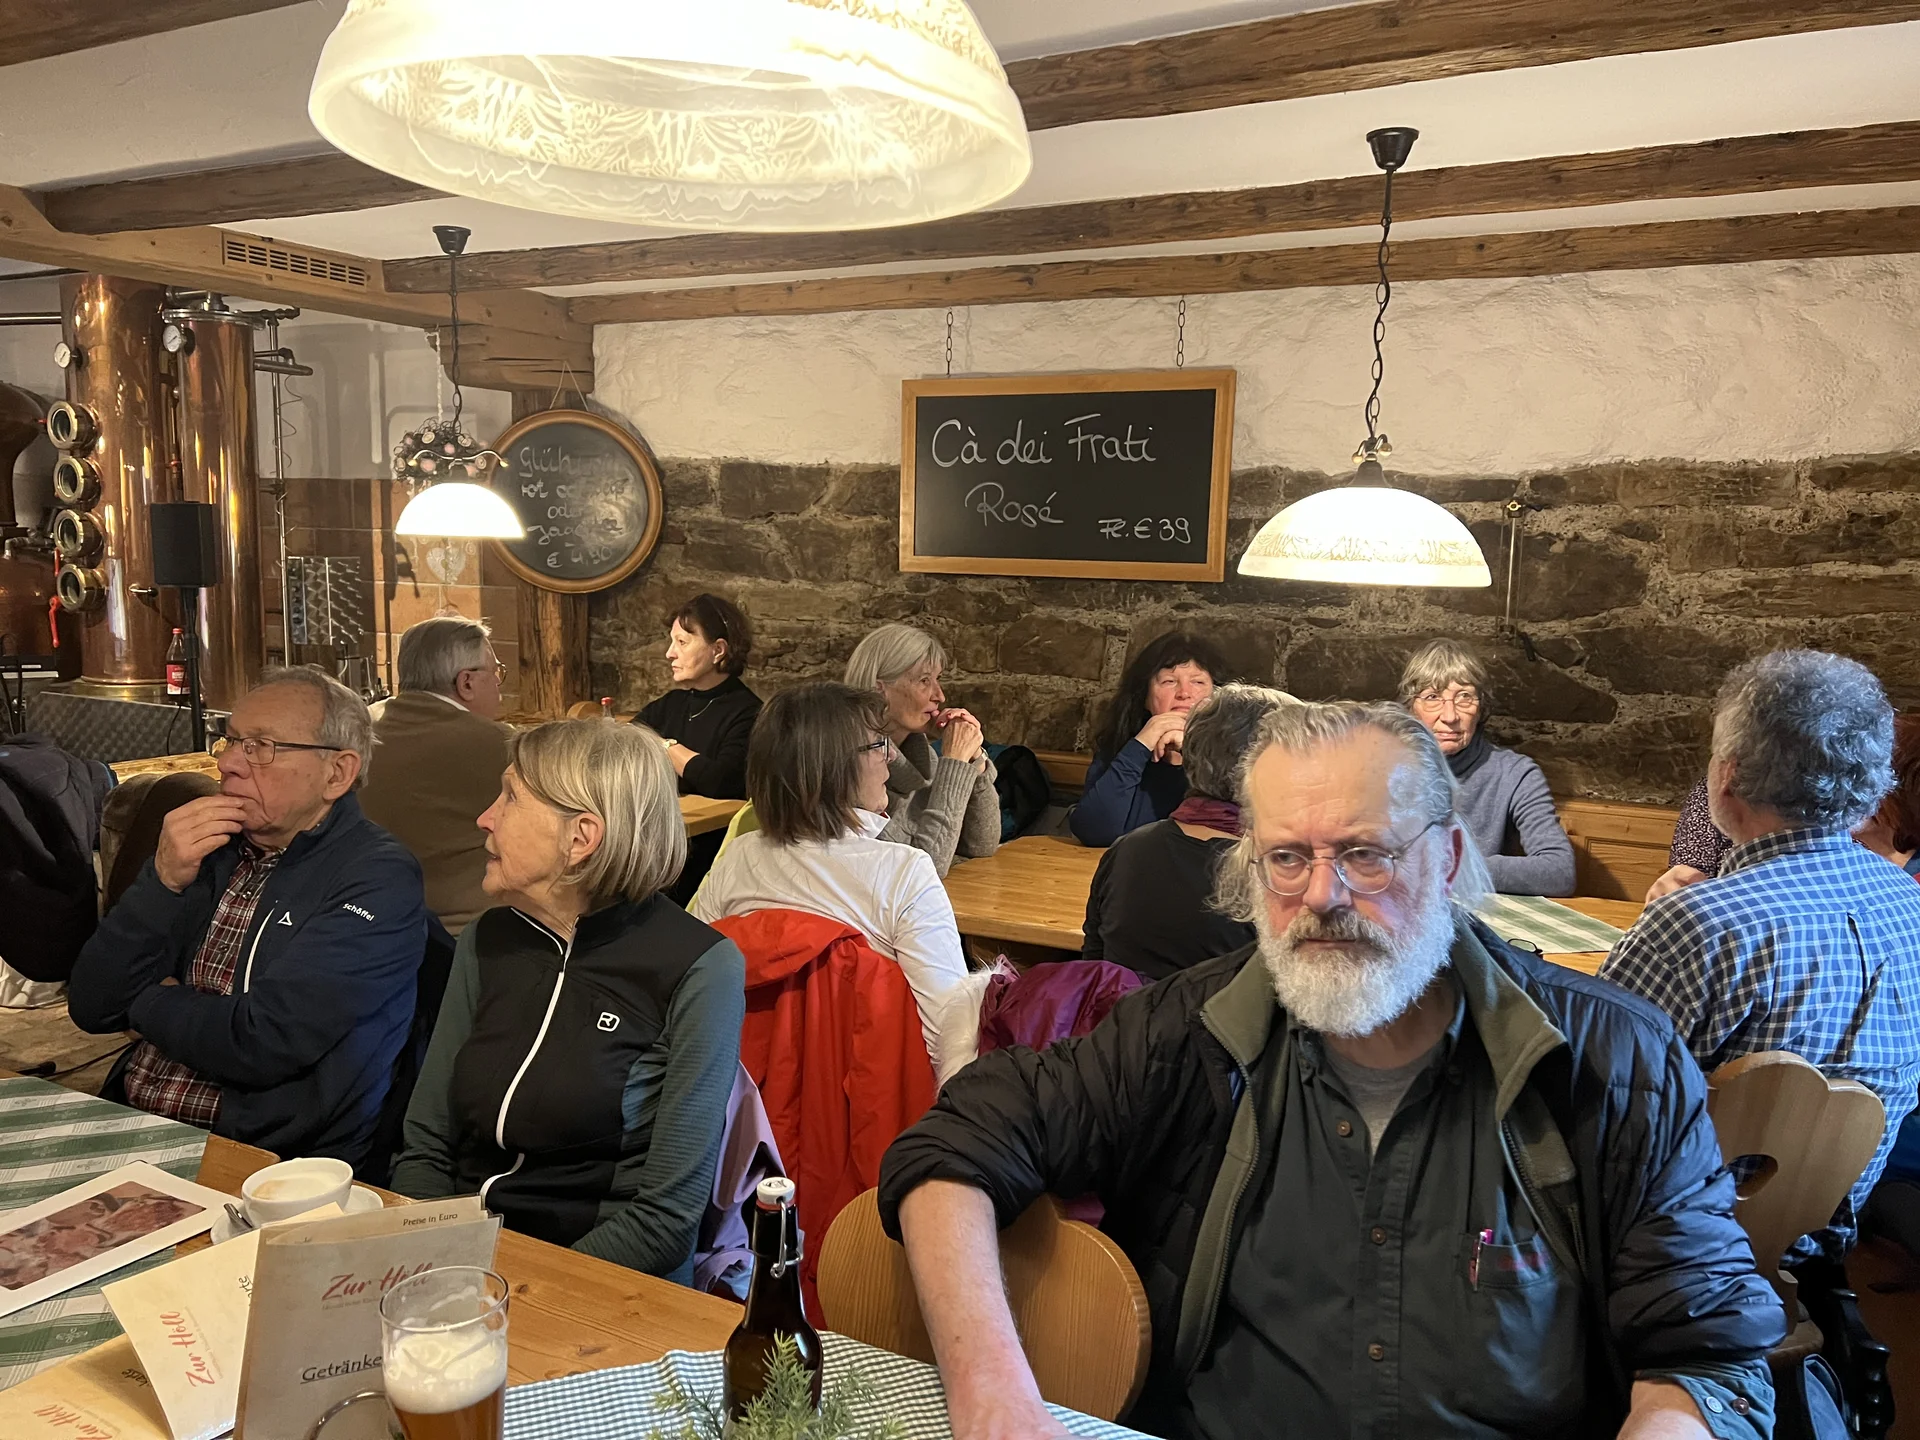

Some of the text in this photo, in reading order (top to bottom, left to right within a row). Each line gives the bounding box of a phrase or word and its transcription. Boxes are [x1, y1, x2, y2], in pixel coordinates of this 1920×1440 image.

[932, 413, 1157, 468] Cà dei Frati
[965, 482, 1064, 528] Rosé
[342, 902, 375, 922] schöffel
[402, 1212, 459, 1226] Preise in Euro
[321, 1273, 372, 1301] Zur
[160, 1311, 196, 1348] Höll
[185, 1352, 215, 1387] Zur
